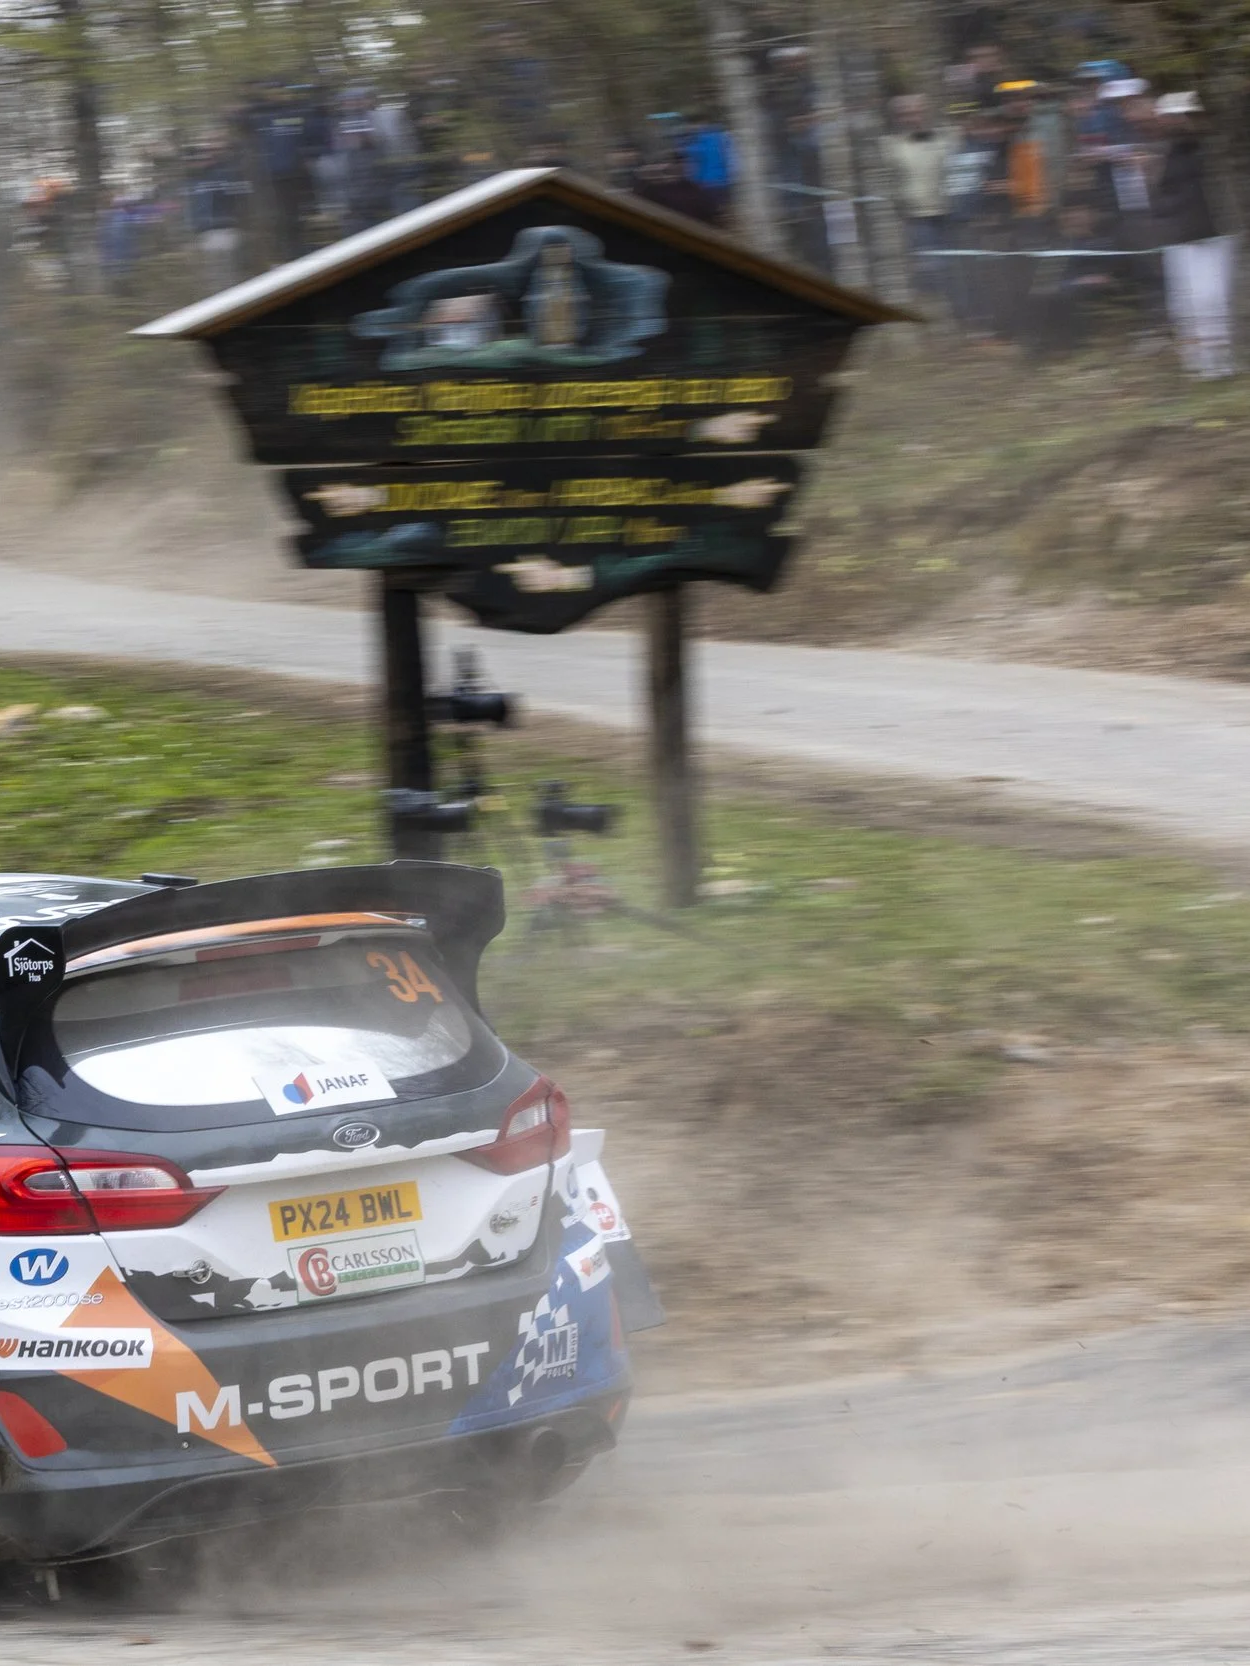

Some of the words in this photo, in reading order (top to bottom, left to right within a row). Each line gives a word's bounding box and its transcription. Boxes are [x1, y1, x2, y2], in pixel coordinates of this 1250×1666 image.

[14, 956, 54, 975] Sjötorps
[366, 951, 444, 1003] 34
[316, 1073, 370, 1094] JANAF
[345, 1127, 370, 1144] Ford
[280, 1197, 351, 1236] PX24
[359, 1189, 414, 1225] BWL
[331, 1244, 416, 1272] CARLSSON
[175, 1341, 490, 1433] M-SPORT
